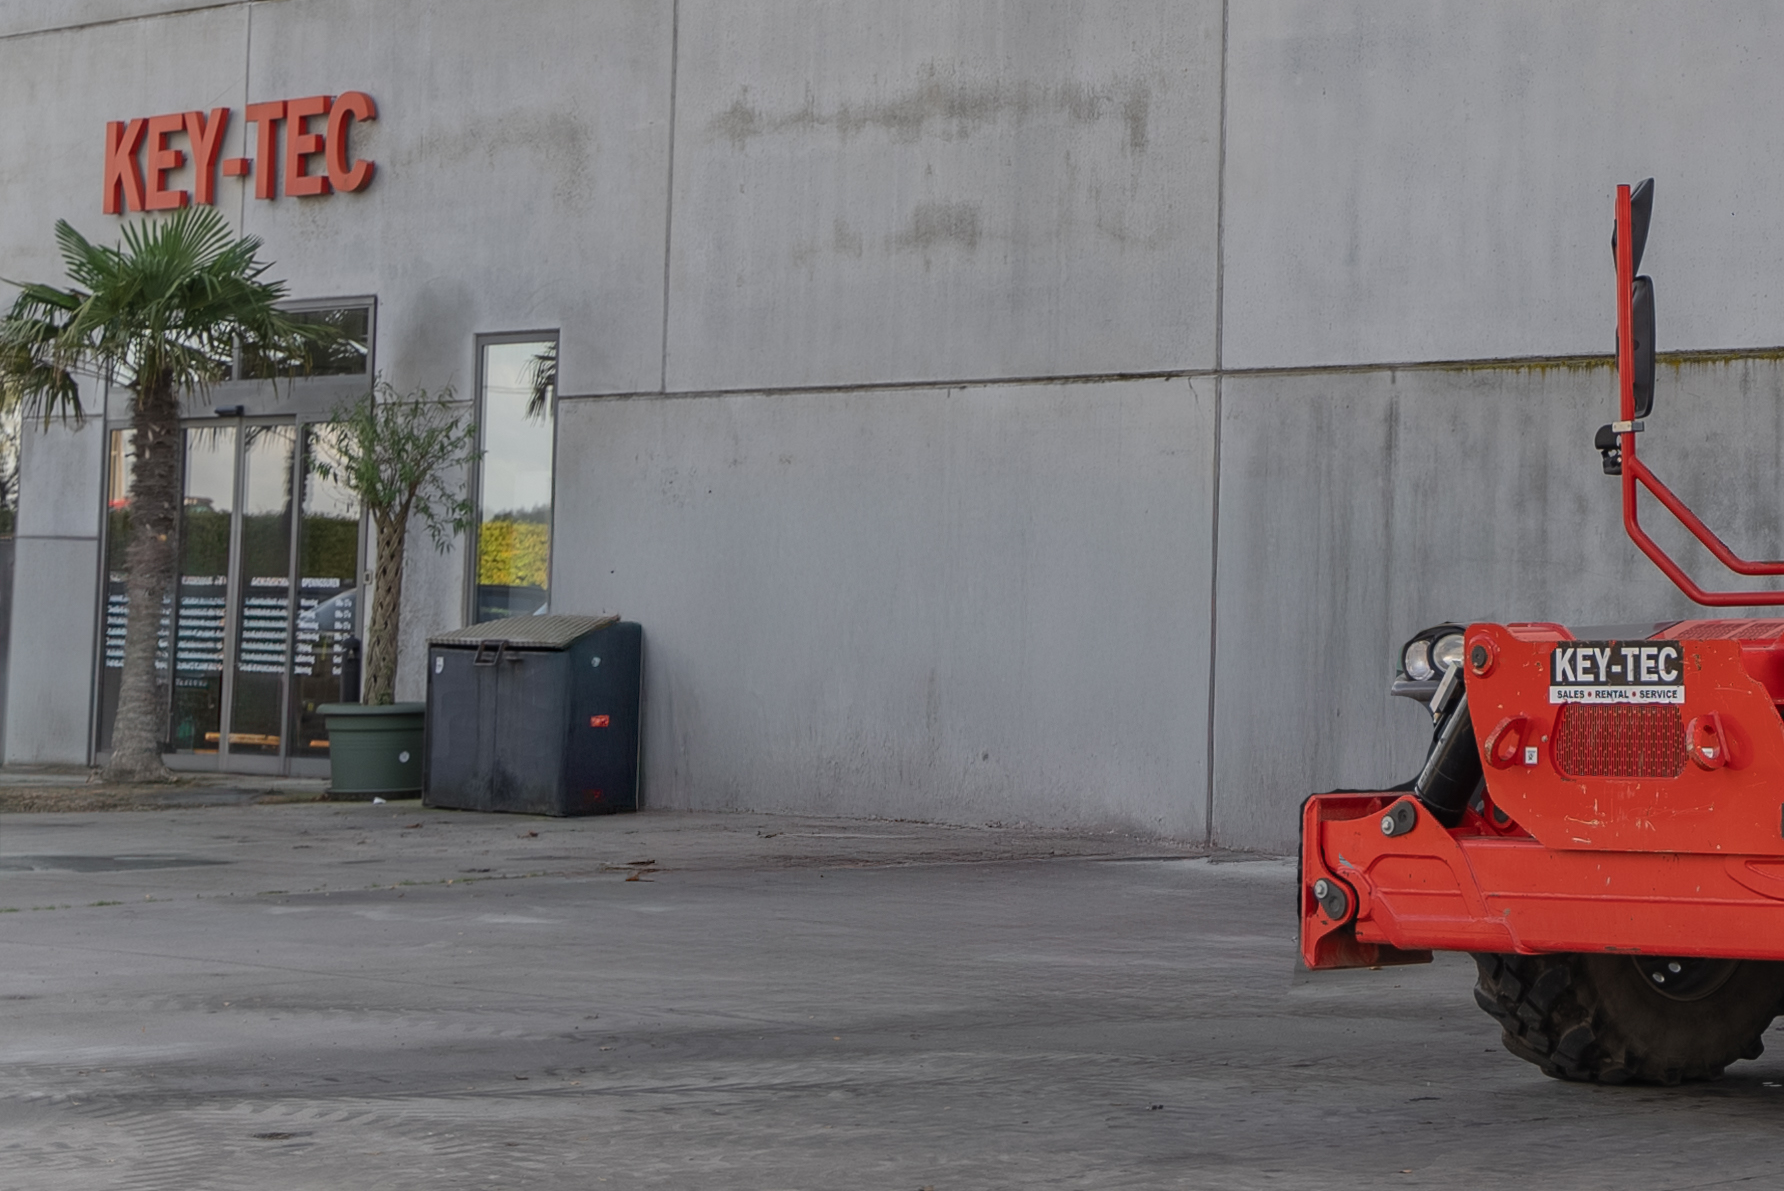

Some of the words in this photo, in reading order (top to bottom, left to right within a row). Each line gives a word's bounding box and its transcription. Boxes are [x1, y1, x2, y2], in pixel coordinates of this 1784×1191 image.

[103, 91, 376, 215] KEY-TEC
[1555, 647, 1679, 682] KEY-TEC
[1557, 690, 1585, 699] SALES
[1595, 690, 1629, 699] RENTAL
[1639, 690, 1678, 699] SERVICE
